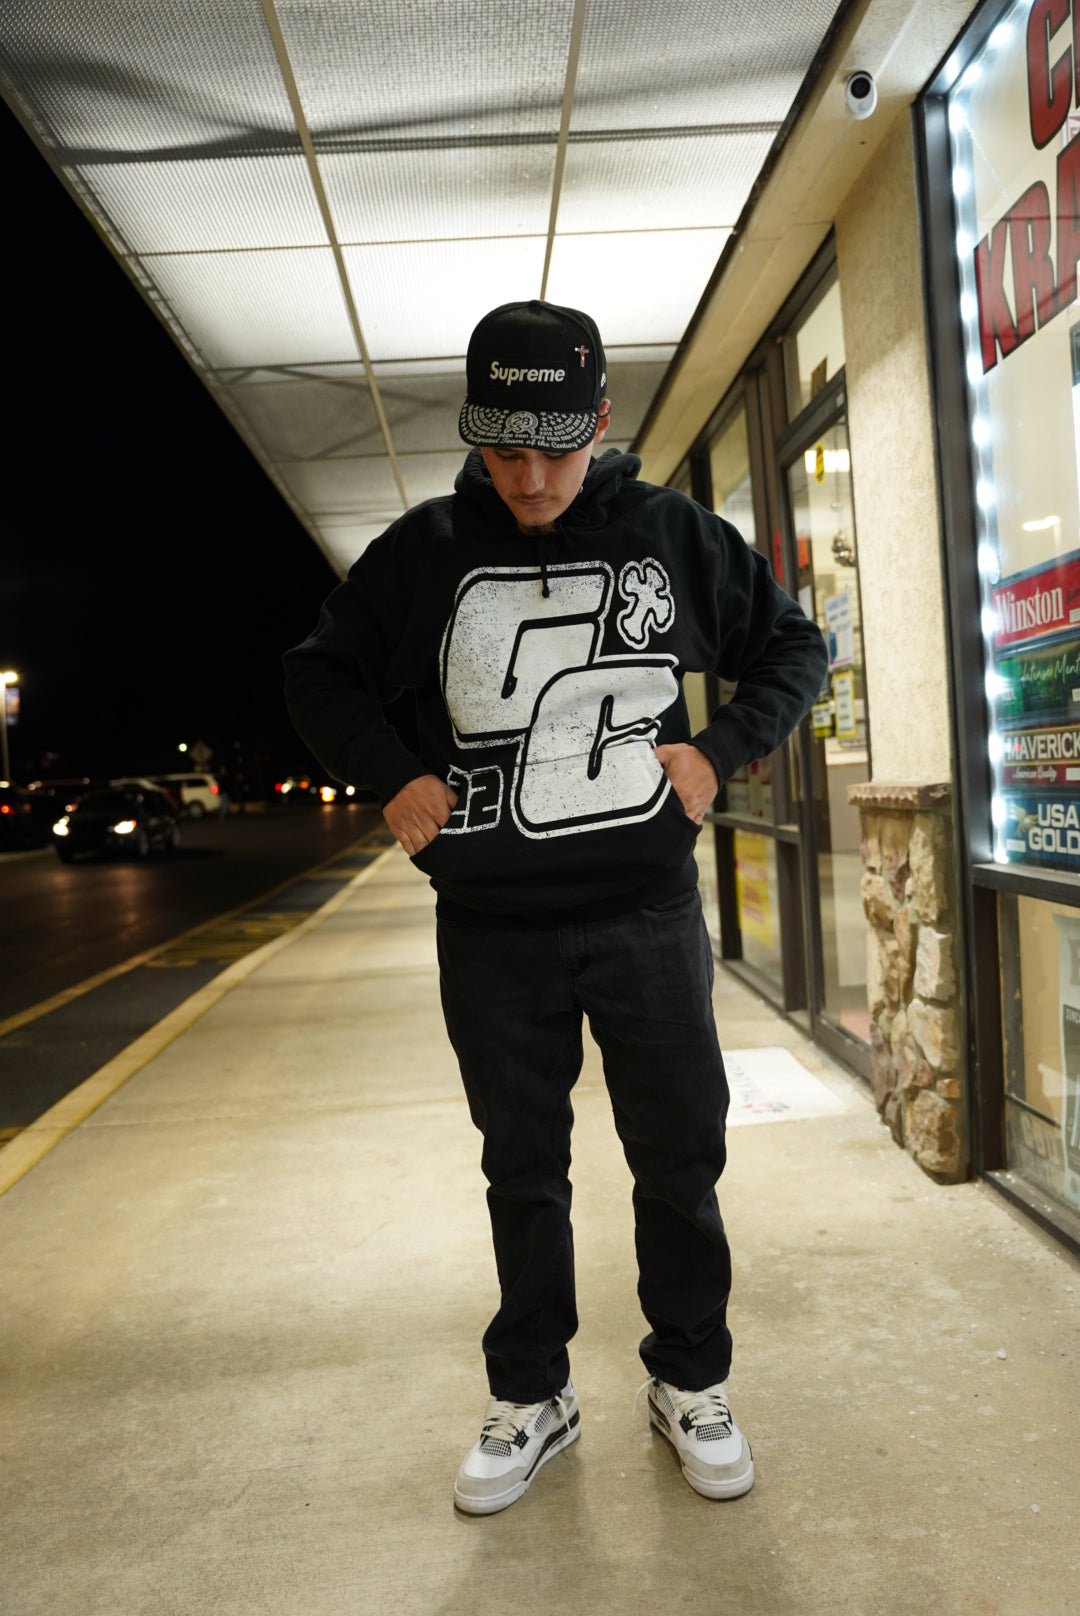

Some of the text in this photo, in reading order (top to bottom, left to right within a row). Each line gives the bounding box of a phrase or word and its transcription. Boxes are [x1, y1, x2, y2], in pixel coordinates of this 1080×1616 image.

[490, 361, 565, 386] Supreme
[995, 586, 1064, 635] Winston
[1004, 731, 1080, 761] MAVERICK
[1037, 803, 1079, 828] USA
[1028, 827, 1080, 855] GOLD
